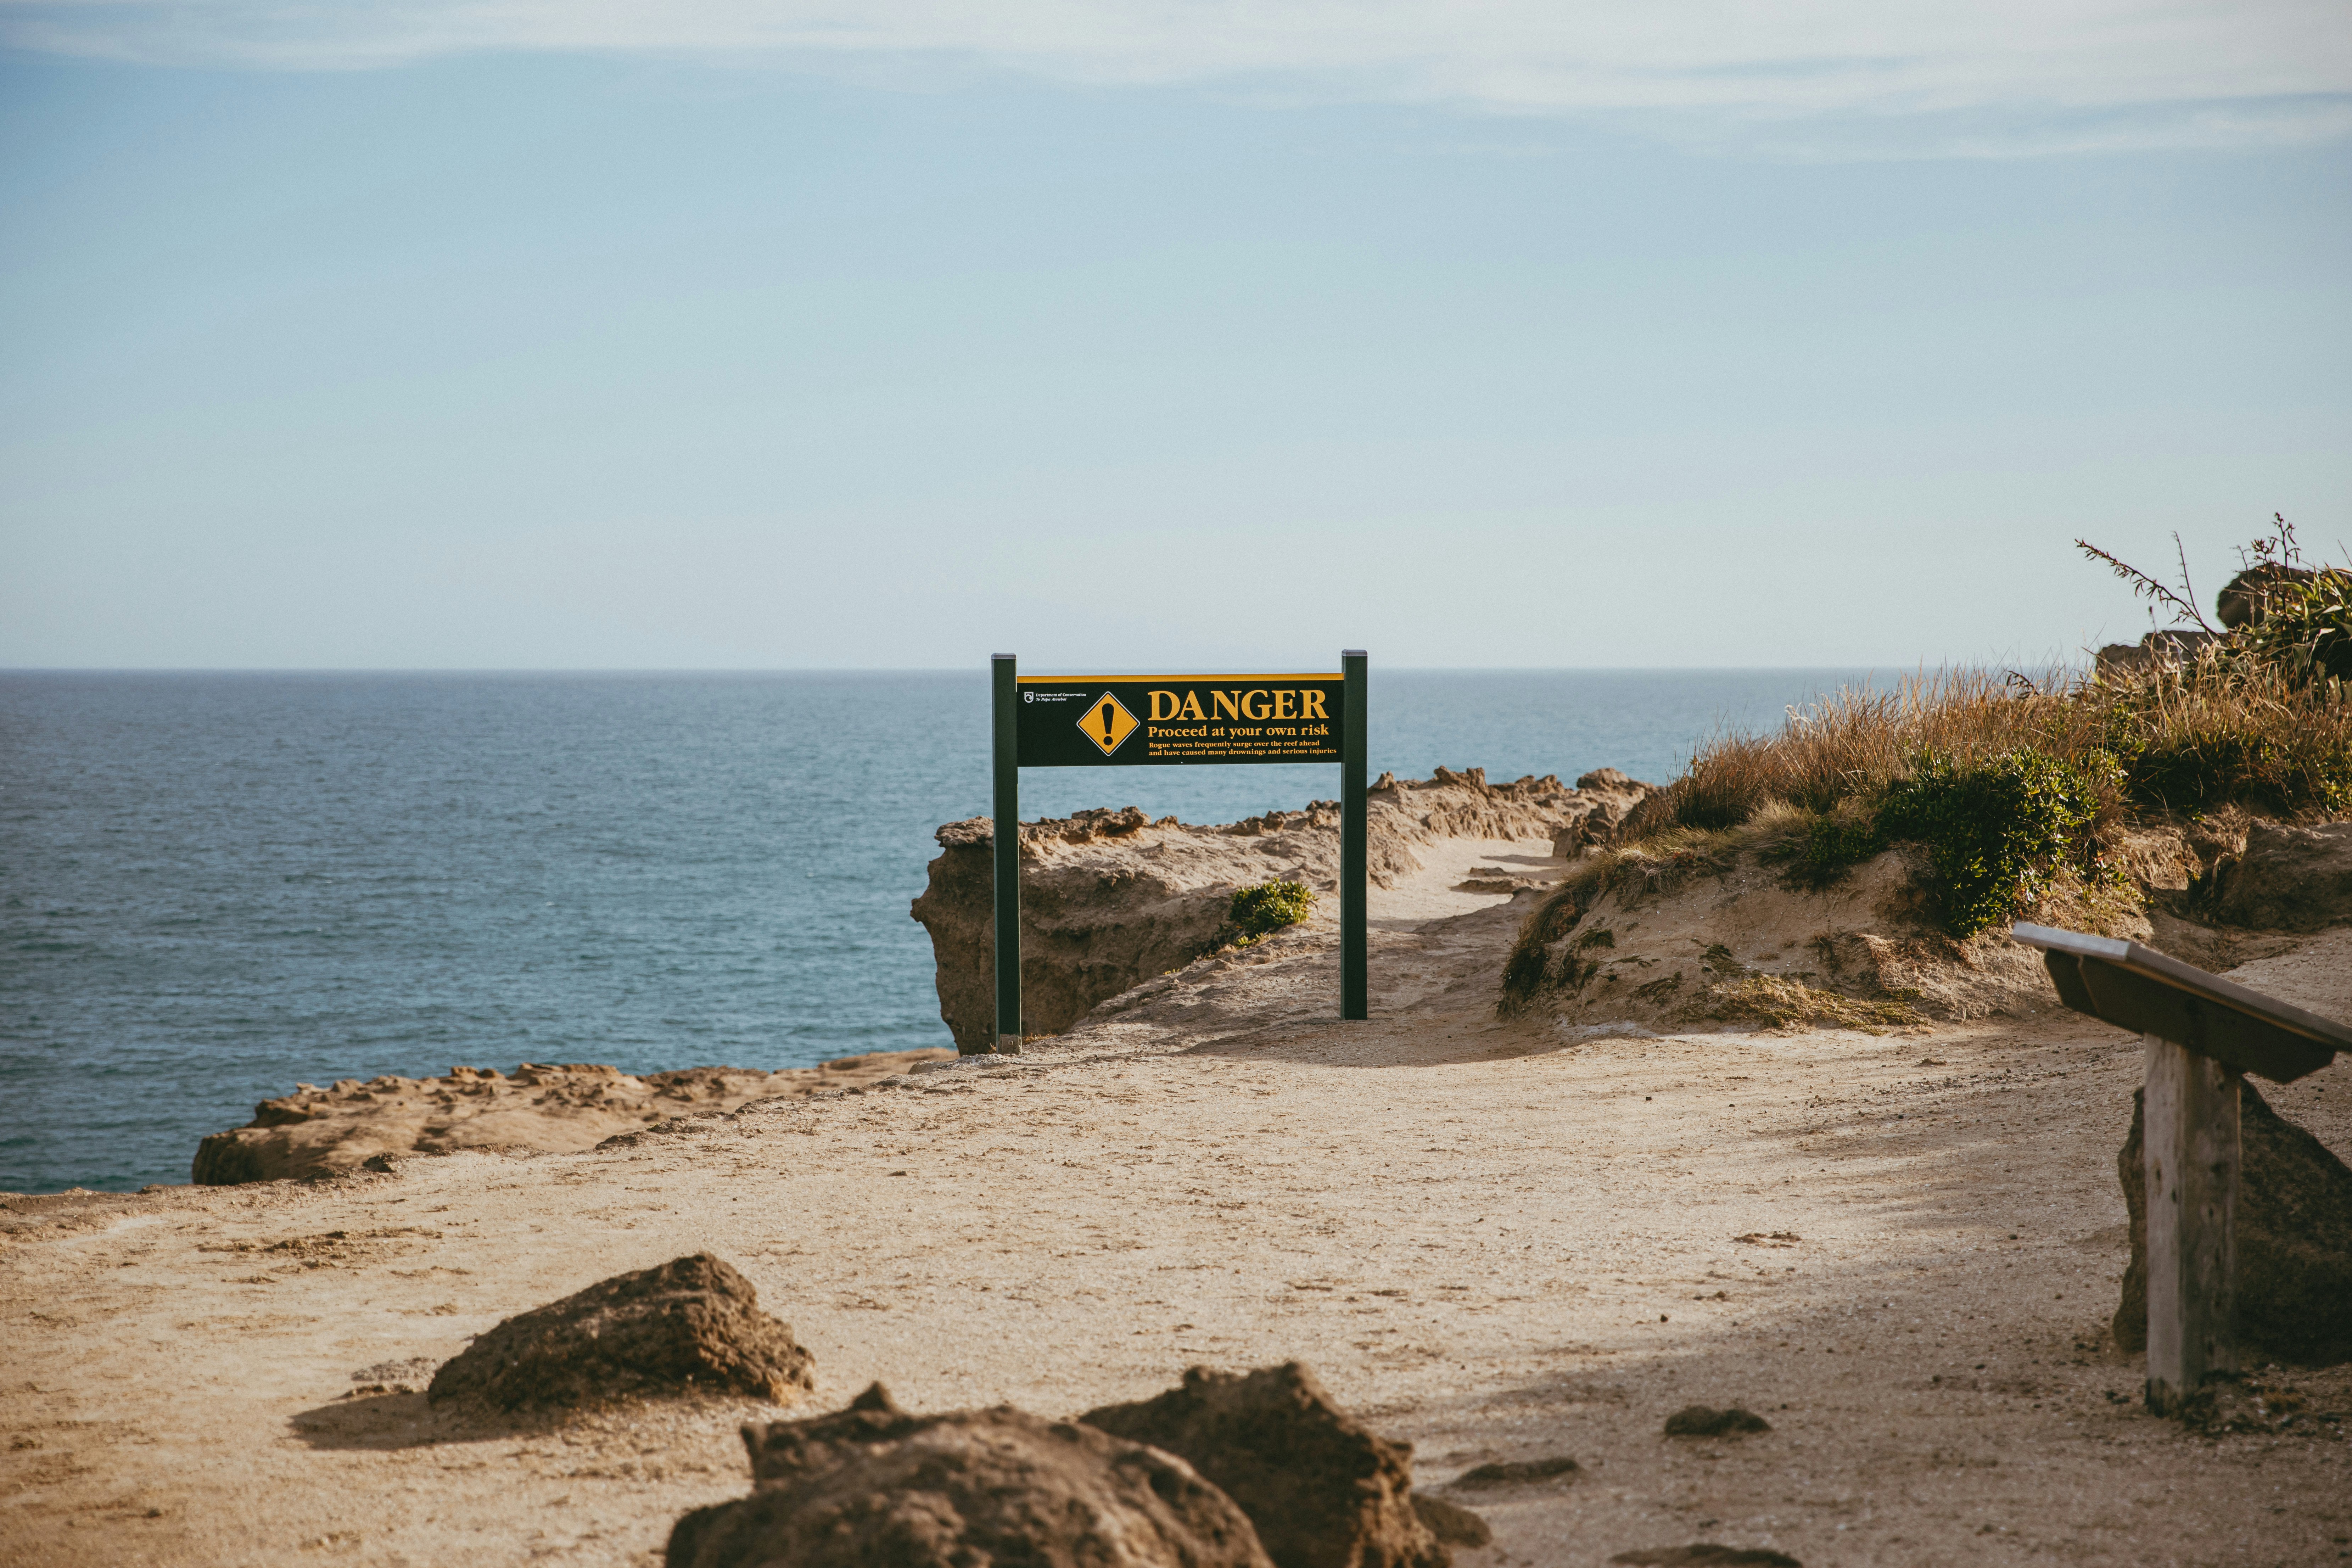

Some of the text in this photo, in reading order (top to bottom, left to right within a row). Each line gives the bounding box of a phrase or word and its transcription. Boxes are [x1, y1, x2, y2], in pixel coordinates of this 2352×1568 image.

[1148, 690, 1329, 721] DANGER
[1148, 725, 1207, 737] Proceed
[1212, 727, 1225, 736] at
[1229, 728, 1262, 739] your
[1301, 724, 1329, 735] risk
